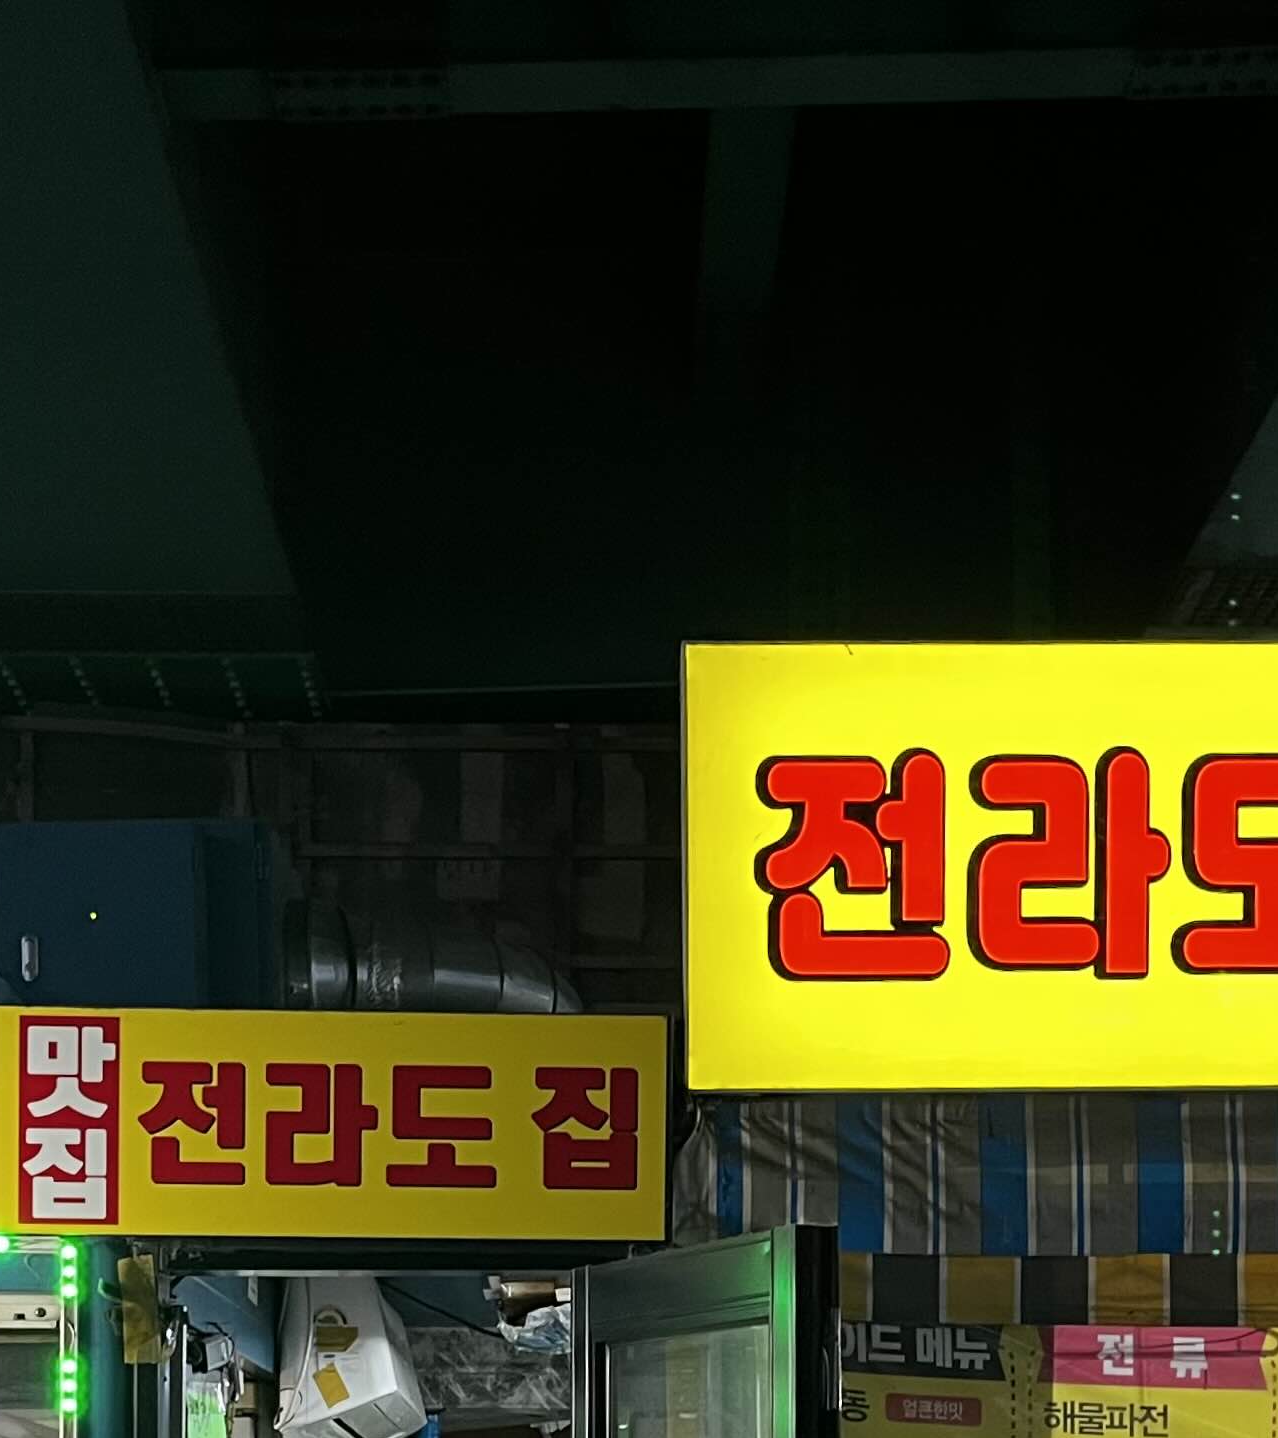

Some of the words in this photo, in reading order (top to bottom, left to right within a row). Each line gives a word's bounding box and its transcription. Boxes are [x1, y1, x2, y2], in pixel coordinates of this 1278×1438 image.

[23, 1025, 116, 1221] 맛집
[137, 1060, 497, 1189] 전라도
[531, 1066, 639, 1190] 집
[916, 1327, 991, 1371] 메뉴
[1043, 1400, 1170, 1438] 해물파전
